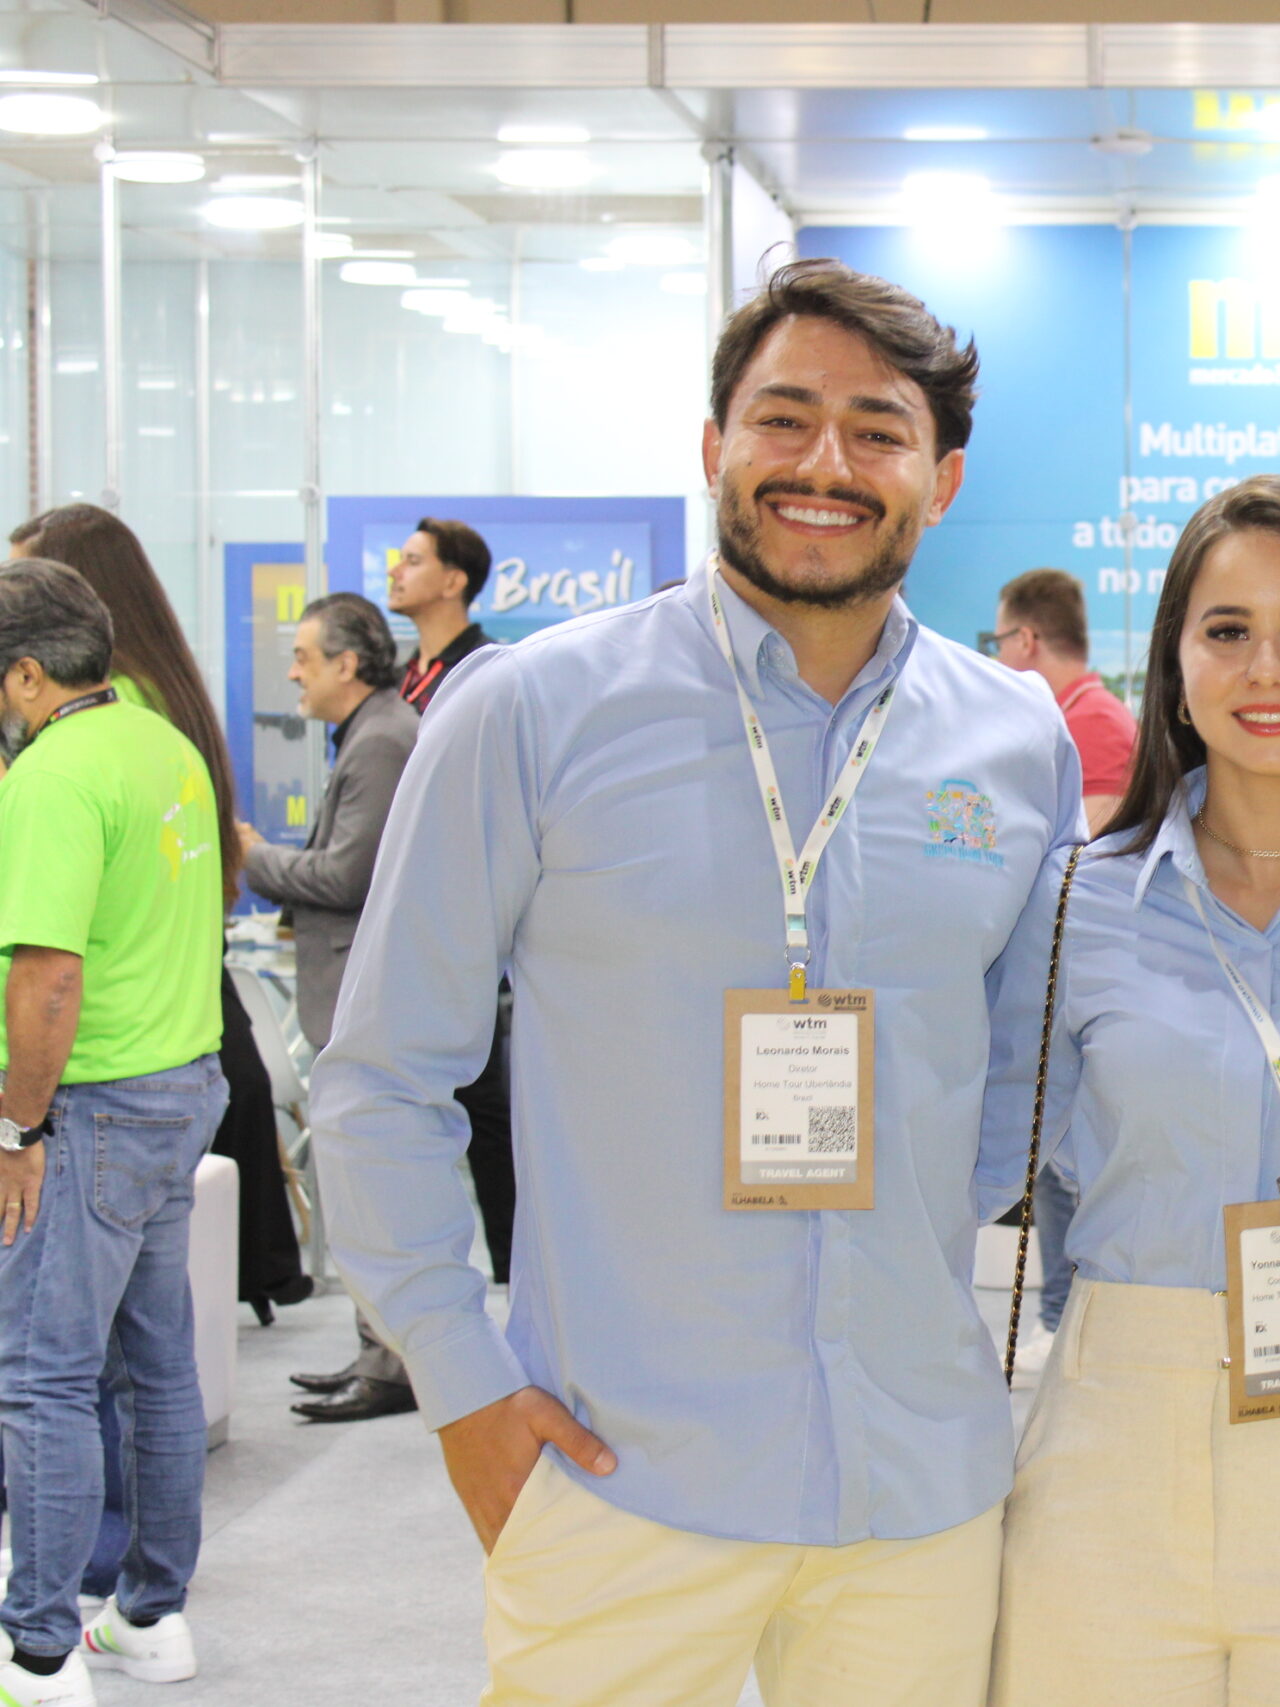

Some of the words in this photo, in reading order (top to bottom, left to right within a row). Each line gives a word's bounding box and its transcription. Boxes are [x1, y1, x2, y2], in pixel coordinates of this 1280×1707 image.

[1119, 474, 1198, 508] para
[1072, 520, 1094, 548] a
[1101, 515, 1177, 548] tudo
[491, 548, 635, 616] Brasil
[1098, 567, 1141, 594] no
[834, 993, 866, 1005] wtm
[793, 1017, 827, 1029] wtm
[756, 1045, 809, 1056] Leonardo
[812, 1045, 850, 1056] Morais
[753, 1079, 780, 1089] Home
[760, 1167, 803, 1178] TRAVEL
[806, 1167, 847, 1178] AGENT
